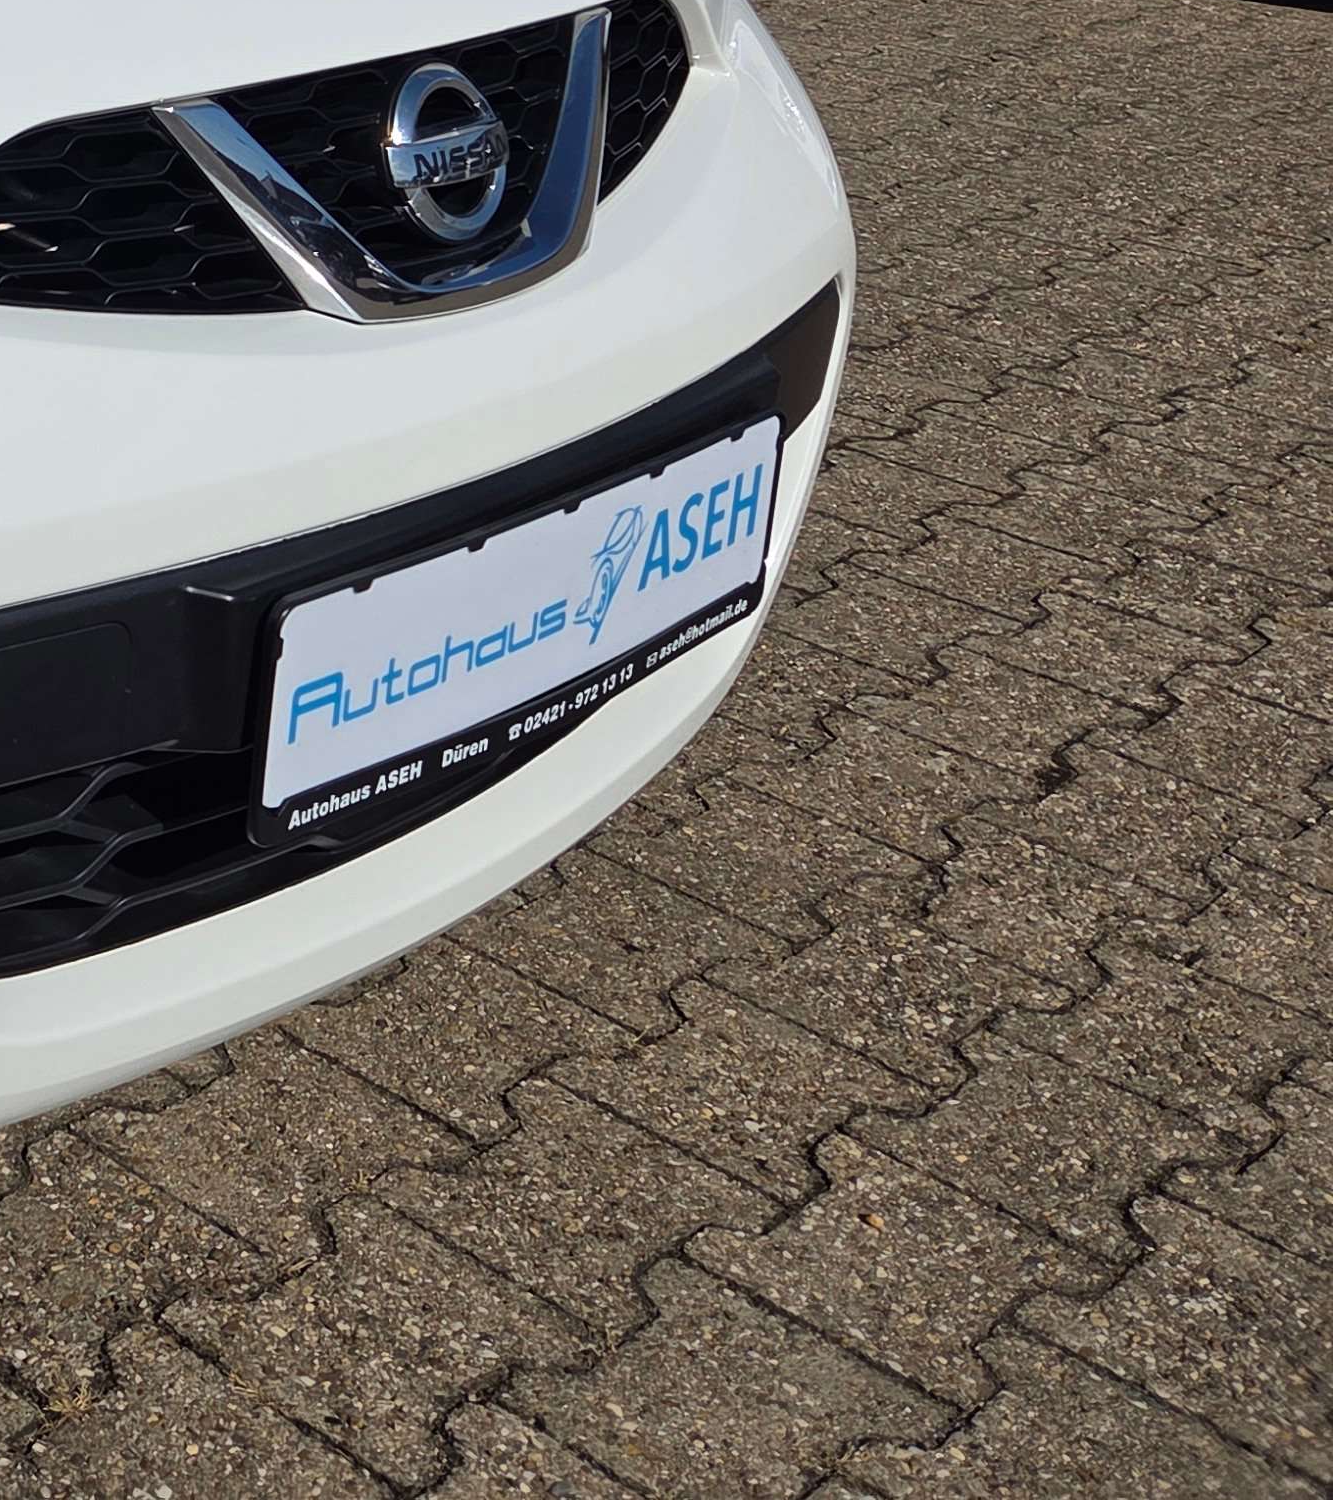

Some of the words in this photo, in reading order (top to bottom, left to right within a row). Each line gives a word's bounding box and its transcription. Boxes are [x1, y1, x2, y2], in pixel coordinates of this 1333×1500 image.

[287, 598, 568, 744] Autohaus
[637, 463, 764, 593] ASEH
[287, 784, 372, 830] Autohaus
[374, 760, 424, 795] ASEH
[441, 738, 490, 768] Düren
[602, 672, 617, 695] 13
[619, 663, 634, 684] 13
[658, 598, 749, 661] aseh@hotmail.de
